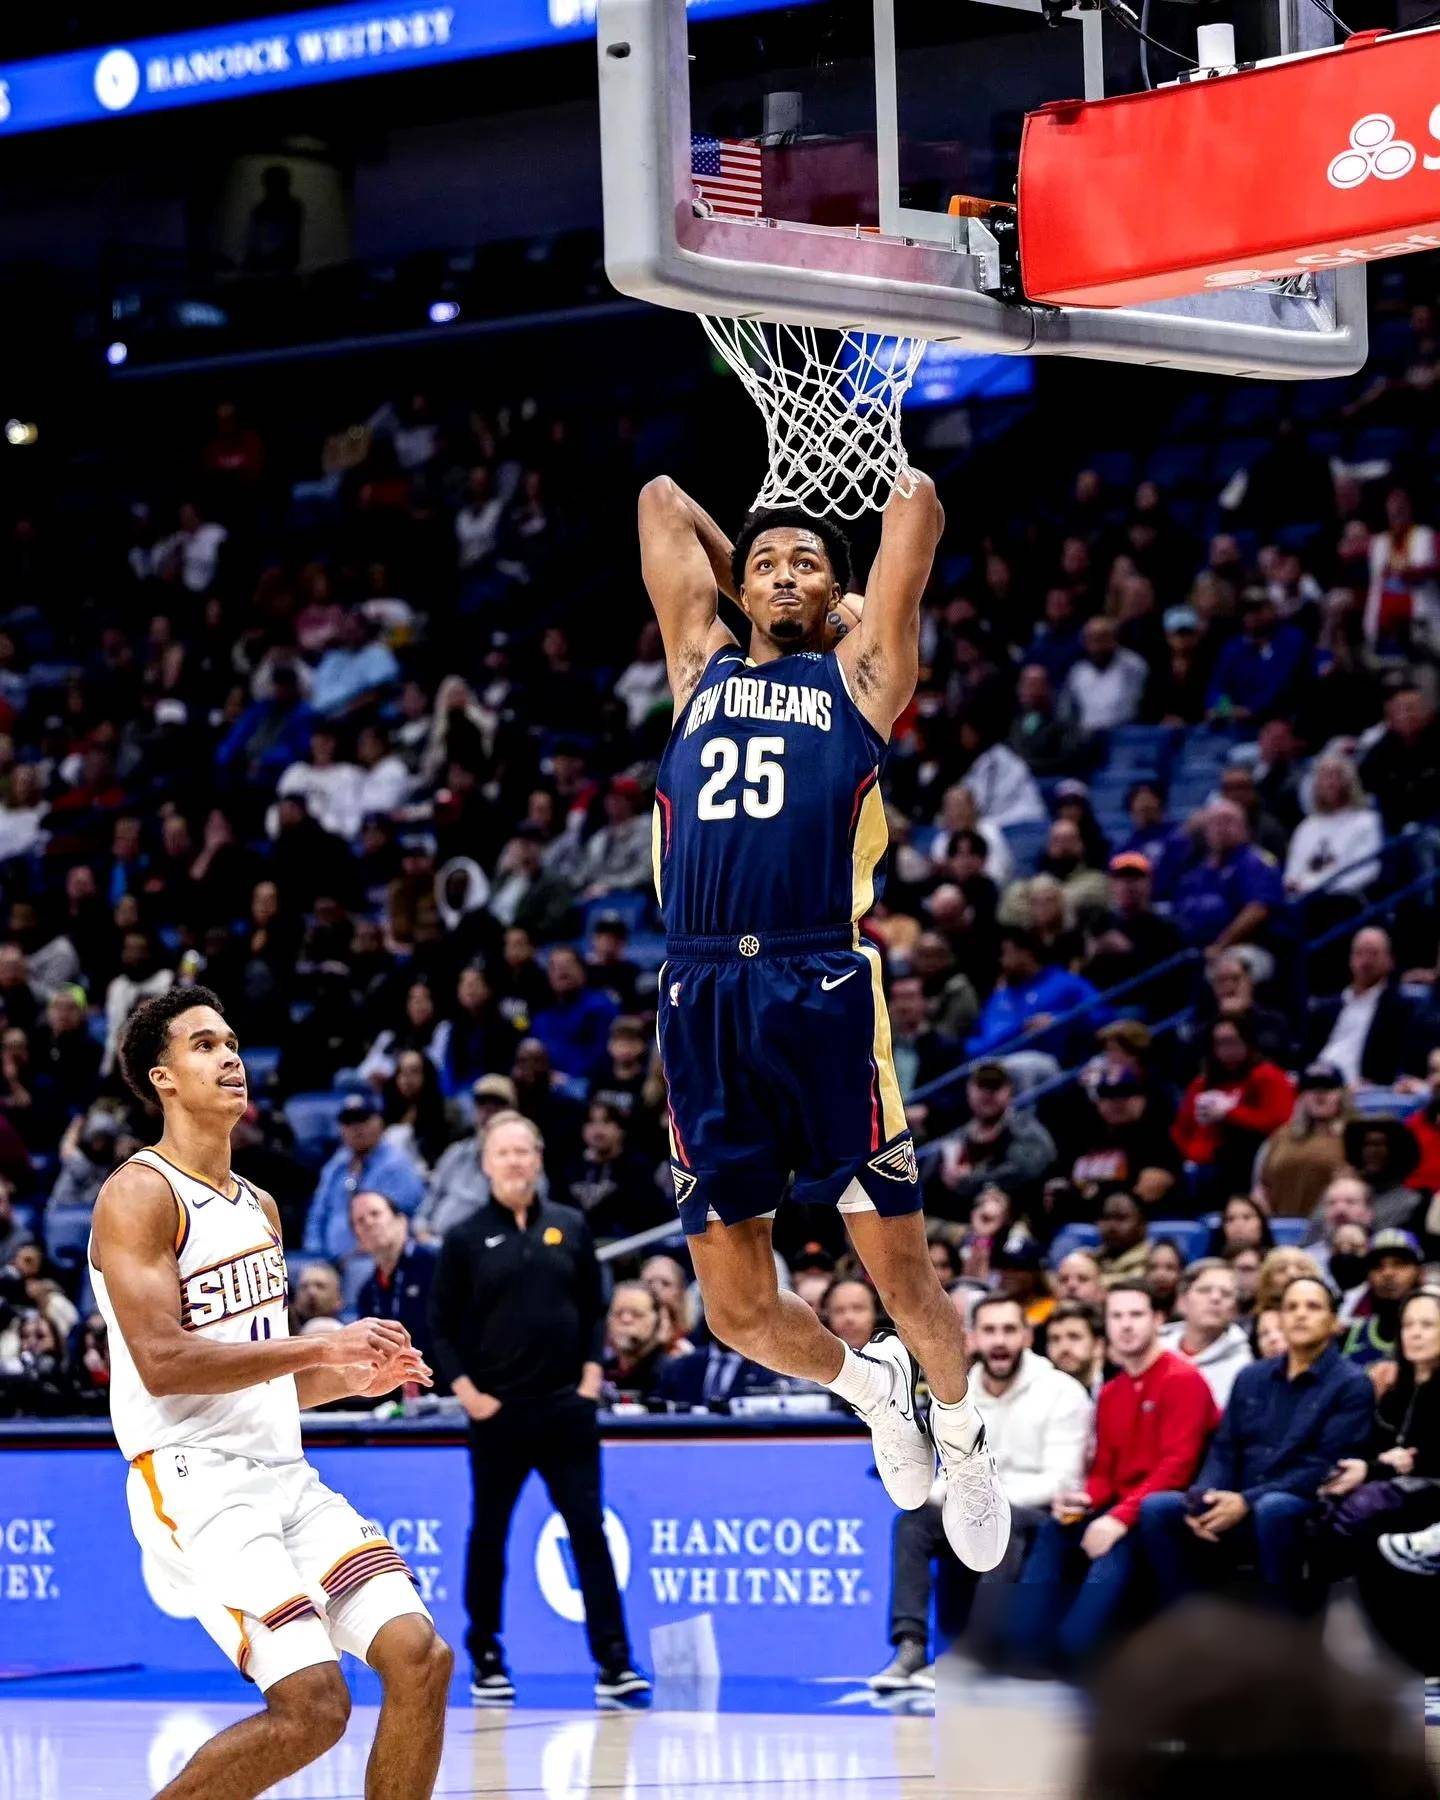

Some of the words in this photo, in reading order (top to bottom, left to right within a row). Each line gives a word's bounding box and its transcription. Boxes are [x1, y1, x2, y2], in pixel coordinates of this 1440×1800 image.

[146, 38, 291, 93] HANCOCK
[296, 9, 454, 65] WHITNEY
[683, 680, 725, 741] NEW
[723, 676, 833, 732] ORLEANS
[697, 736, 785, 821] 25
[186, 1247, 287, 1327] SUNS
[650, 1517, 865, 1556] HANCOCK
